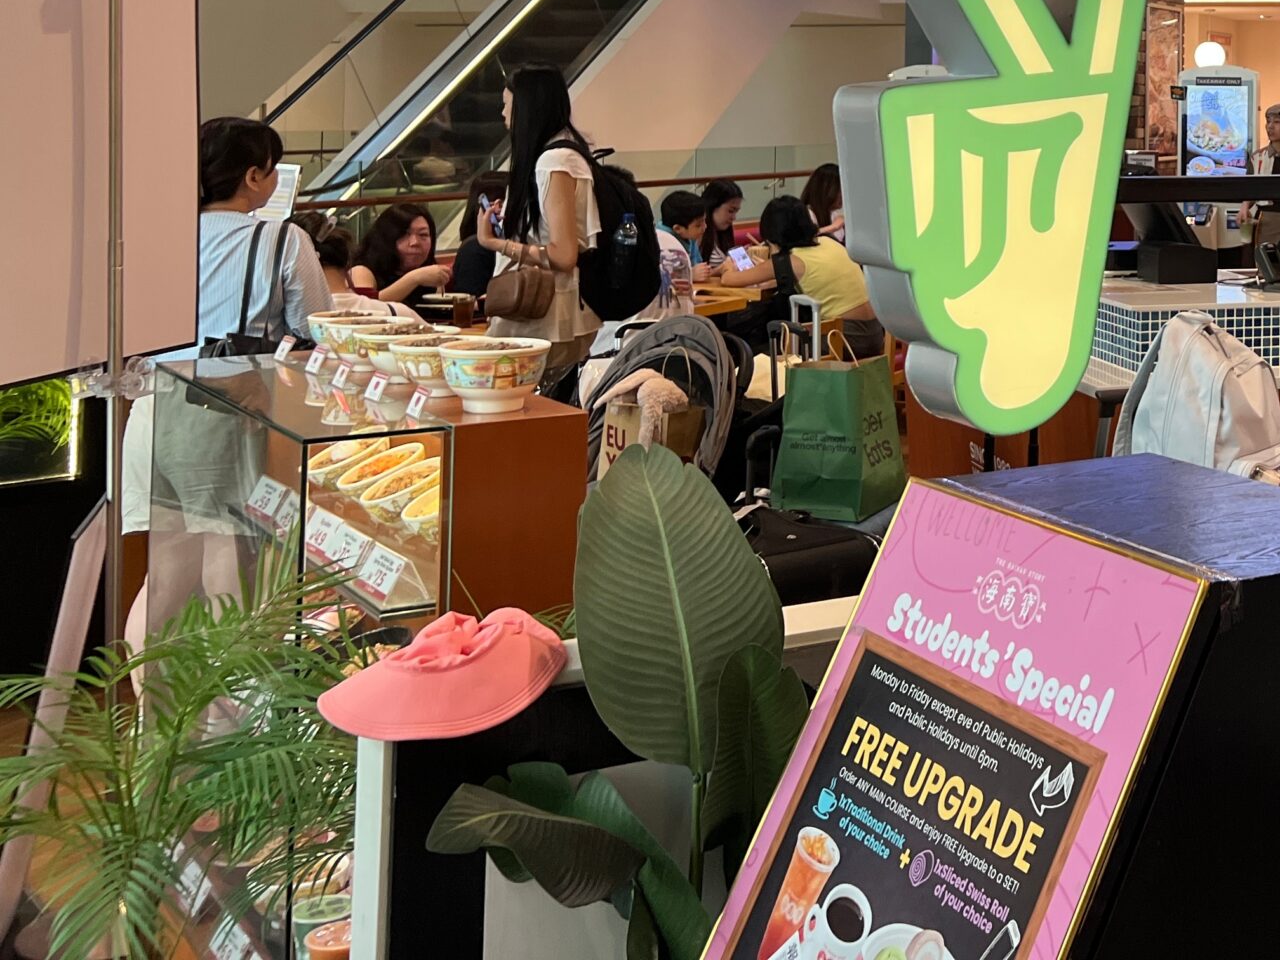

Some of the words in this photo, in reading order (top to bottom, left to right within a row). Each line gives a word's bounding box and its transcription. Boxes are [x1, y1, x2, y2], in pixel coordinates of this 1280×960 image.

[606, 424, 626, 452] EU
[1005, 647, 1115, 734] Special
[870, 663, 901, 693] Monday
[899, 679, 909, 694] to
[907, 684, 932, 710] Friday
[930, 697, 959, 722] except
[957, 712, 973, 731] eve
[972, 720, 985, 737] of
[981, 724, 1008, 749] Public
[1006, 740, 1045, 770] Holidays
[888, 701, 905, 718] and
[903, 707, 928, 731] Public
[926, 721, 960, 751] Holidays
[959, 740, 980, 761] until
[977, 748, 999, 773] 6pm.
[840, 715, 910, 787] FREE
[903, 751, 1045, 874] UPGRADE
[838, 816, 851, 829] of
[845, 821, 866, 842] your
[863, 833, 890, 860] choice
[839, 766, 858, 784] Order
[855, 777, 871, 794] ANY
[868, 784, 887, 805] MAIN
[884, 796, 912, 821] COURSE
[909, 814, 926, 830] and
[923, 822, 943, 845] enjoy
[940, 833, 959, 853] FREE
[956, 843, 989, 873] Upgrade
[987, 864, 997, 879] to
[996, 875, 1004, 884] a
[883, 827, 906, 850] Drink
[934, 883, 947, 899] of
[940, 890, 965, 913] your
[965, 880, 992, 910] Swiss
[989, 898, 1011, 923] Roll
[962, 904, 993, 934] choice
